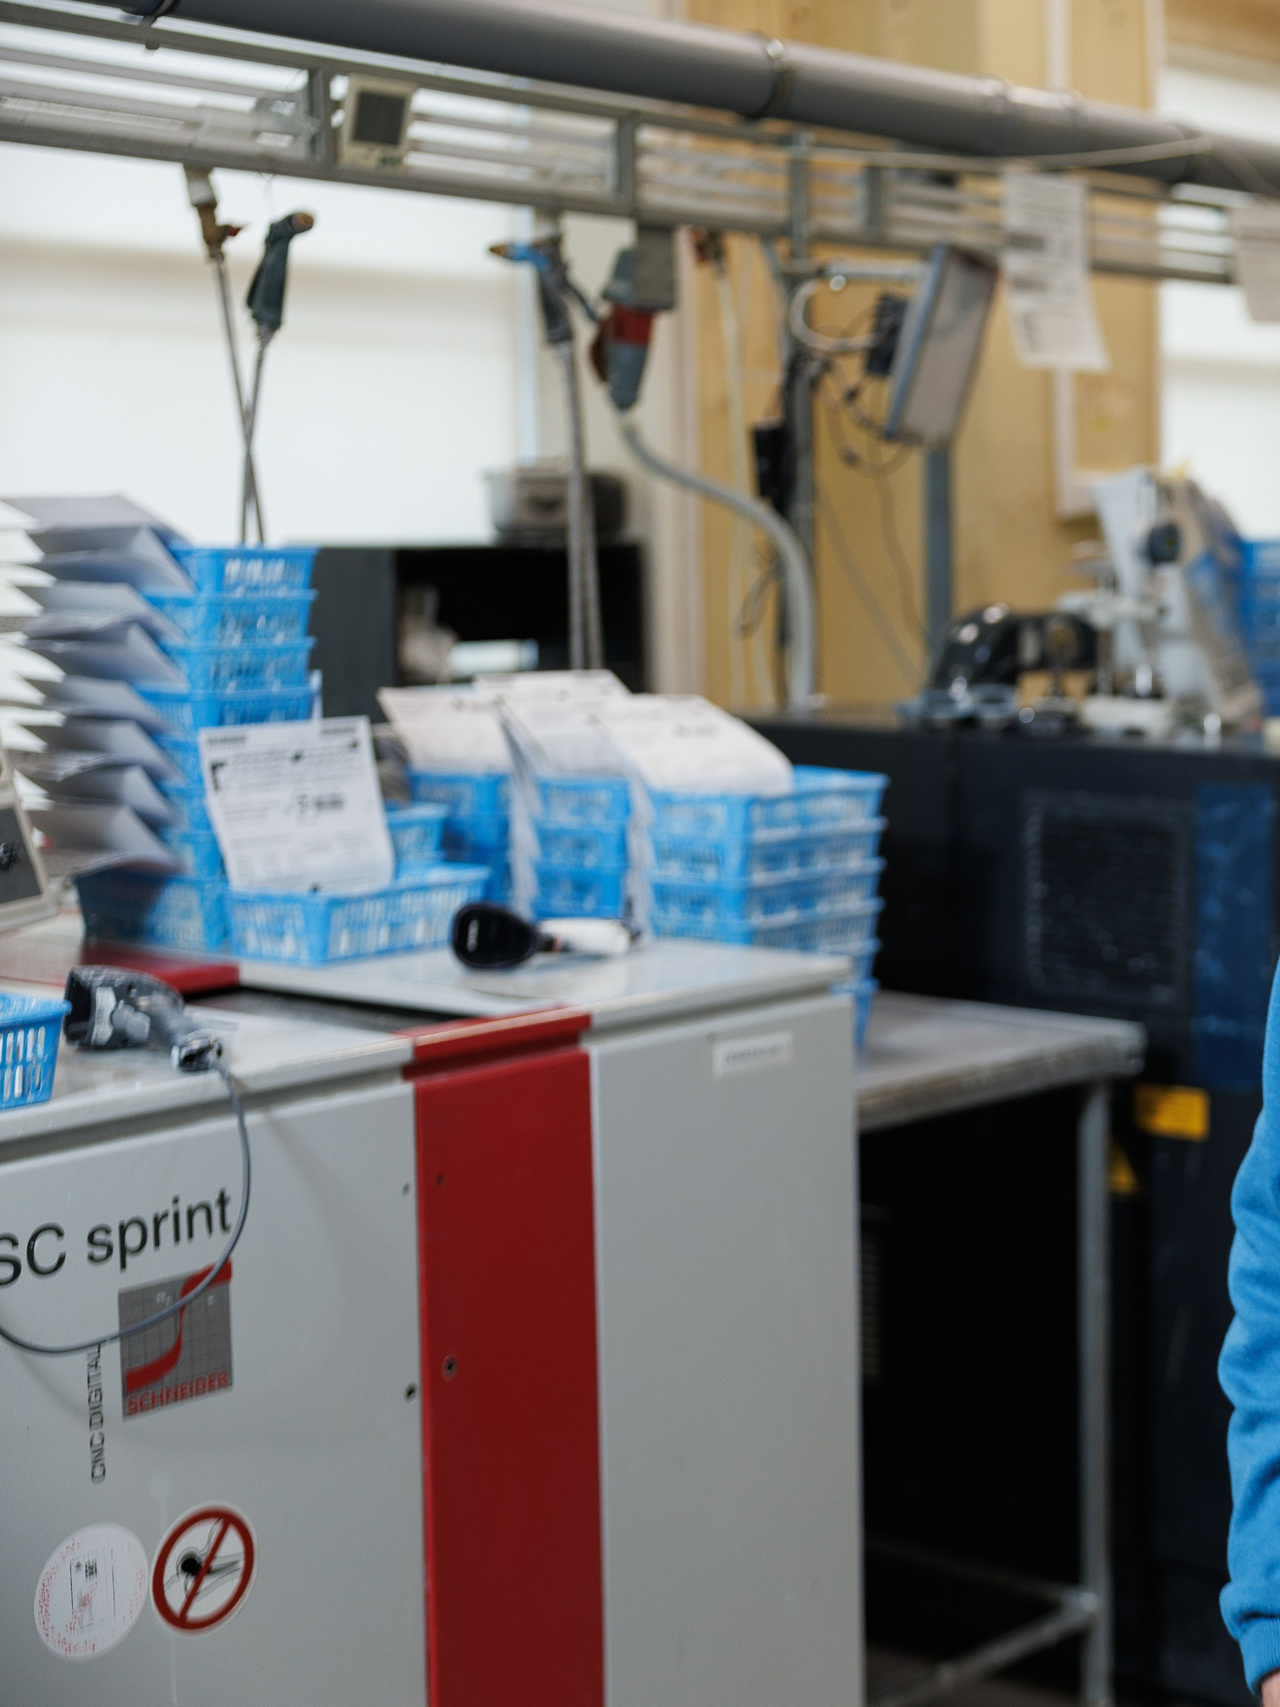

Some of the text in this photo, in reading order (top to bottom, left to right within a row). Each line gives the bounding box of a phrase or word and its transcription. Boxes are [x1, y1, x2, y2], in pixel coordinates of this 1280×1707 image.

[87, 1188, 231, 1271] sprint
[127, 1369, 229, 1416] SCHNEIDER
[91, 1432, 105, 1484] CNC
